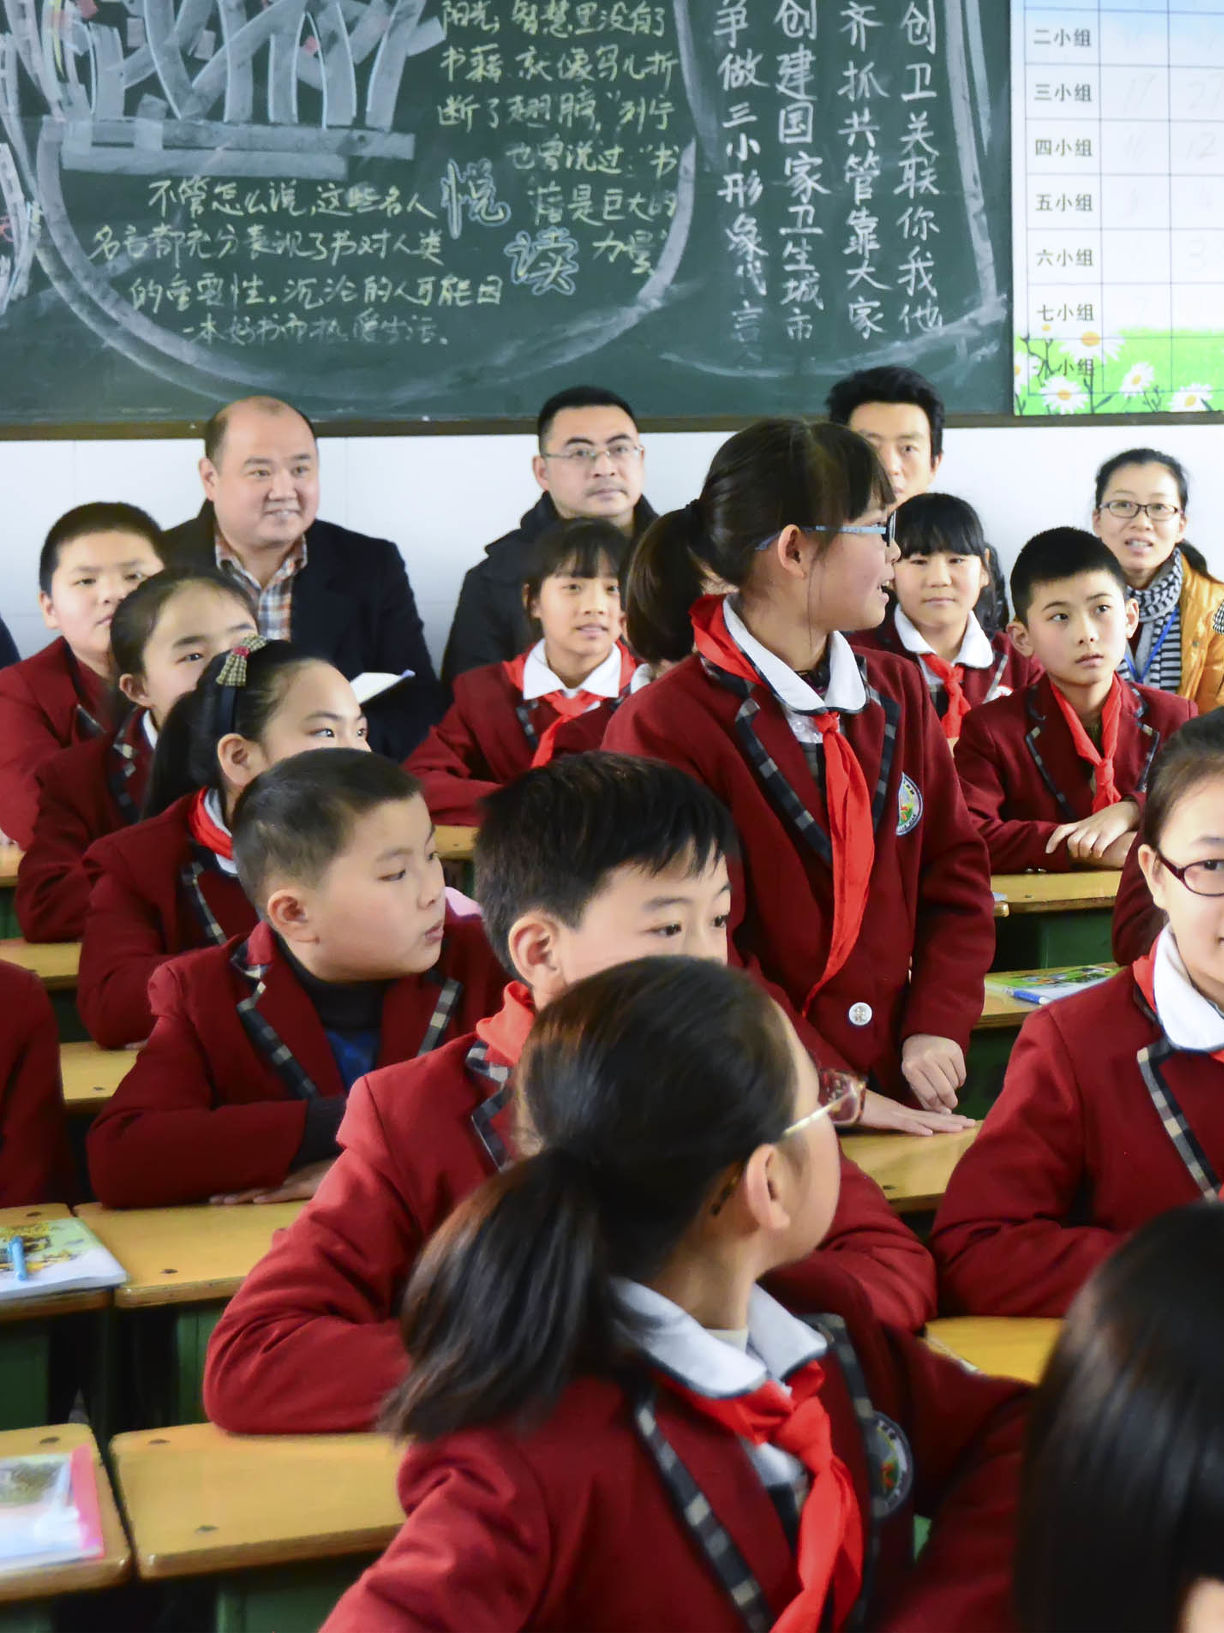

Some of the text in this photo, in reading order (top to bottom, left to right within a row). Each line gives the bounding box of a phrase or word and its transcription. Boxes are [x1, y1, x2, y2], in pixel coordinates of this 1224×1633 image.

[1033, 28, 1091, 47] 二小组
[1034, 83, 1092, 102] 三小组
[1034, 139, 1093, 157] 四小组
[774, 0, 832, 340] 创建国家卫生城市
[837, 3, 893, 339] 齐抓共管靠大家
[893, 0, 944, 334] 创卫关联你我他
[1035, 193, 1093, 213] 五小组
[1036, 249, 1094, 267] 六小组
[1037, 303, 1095, 322] 七小组
